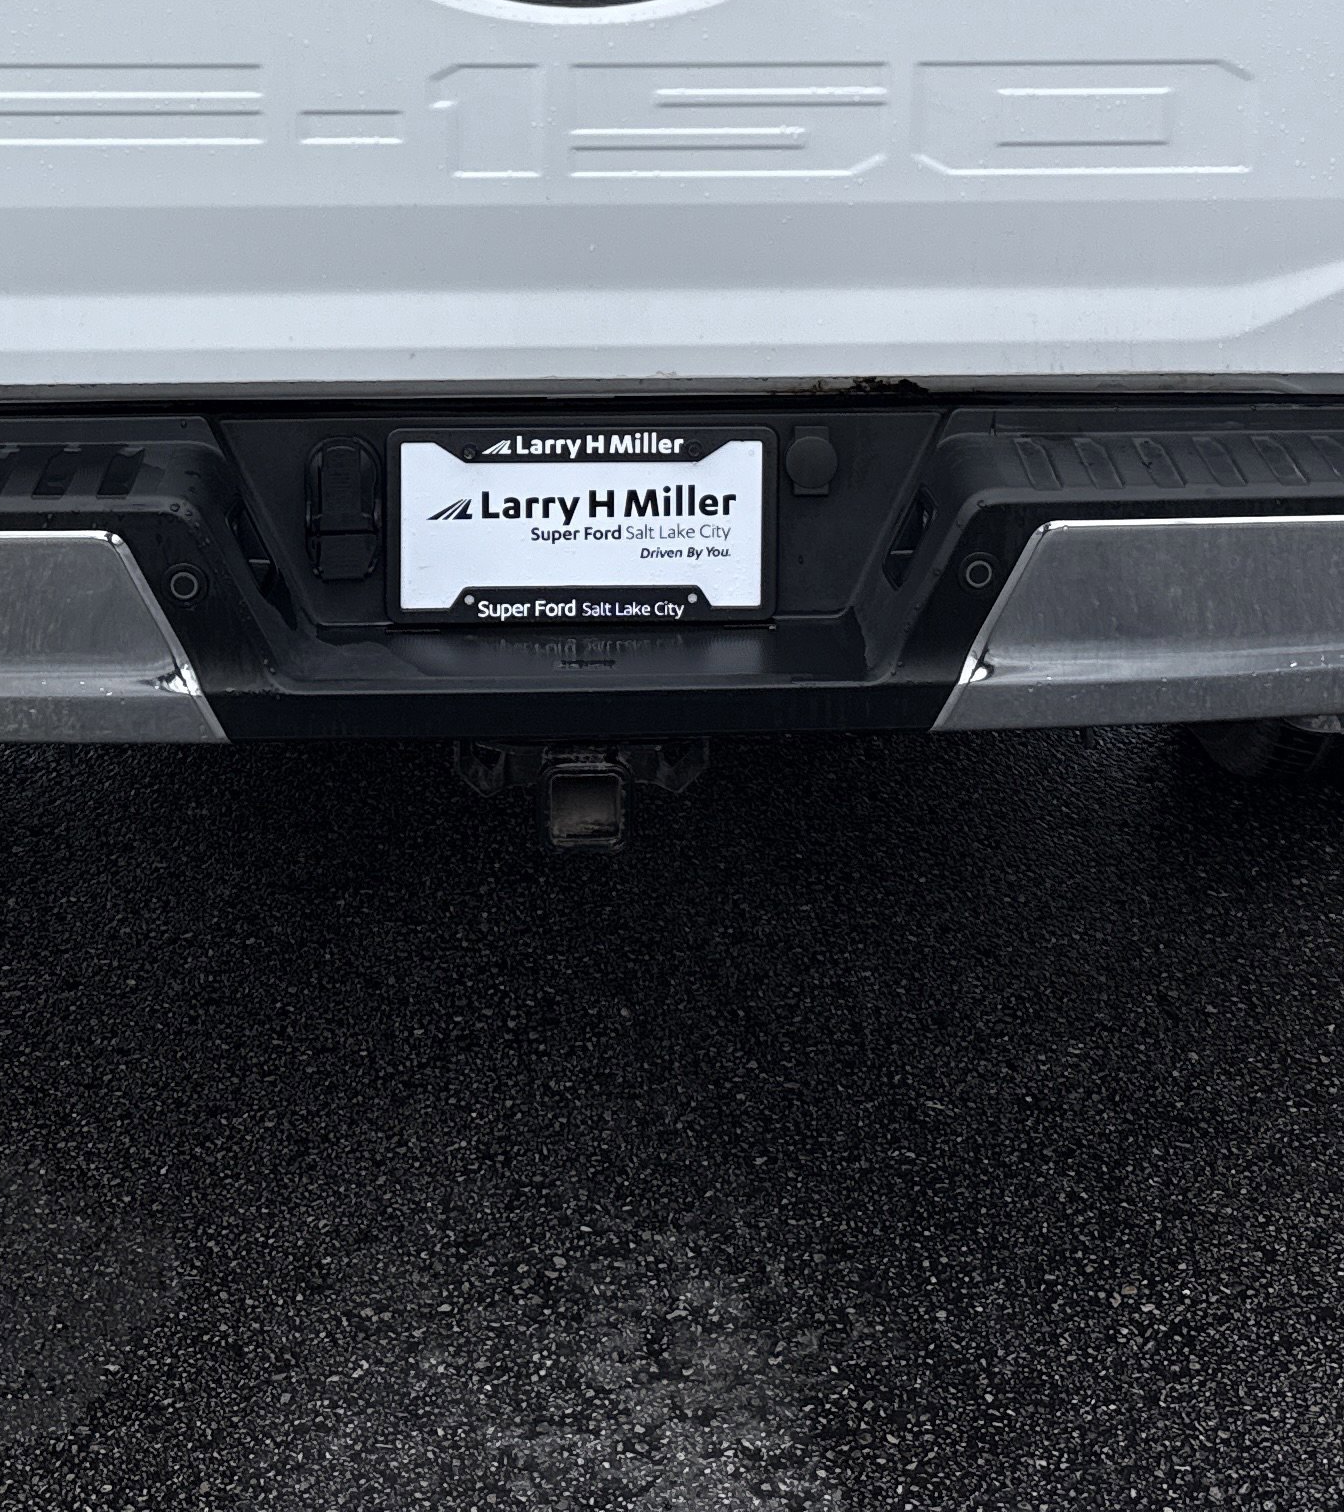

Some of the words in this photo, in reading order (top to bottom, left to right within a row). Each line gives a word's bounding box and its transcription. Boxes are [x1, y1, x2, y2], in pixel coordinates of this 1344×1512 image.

[516, 435, 582, 458] Larry
[586, 435, 605, 454] H
[609, 432, 684, 454] Miller
[481, 491, 581, 526] Larry
[588, 489, 615, 518] H
[623, 484, 737, 518] Miller
[530, 527, 581, 544] Super
[584, 525, 622, 541] Ford
[625, 524, 654, 540] Salt
[659, 523, 696, 539] Lake
[699, 523, 732, 541] City
[639, 547, 683, 560] Driven
[687, 547, 703, 561] By
[705, 546, 731, 558] You.
[477, 600, 530, 621] Super
[535, 599, 576, 617] Ford
[582, 601, 613, 617] Salt
[615, 601, 651, 617] Lake
[654, 600, 685, 620] City
